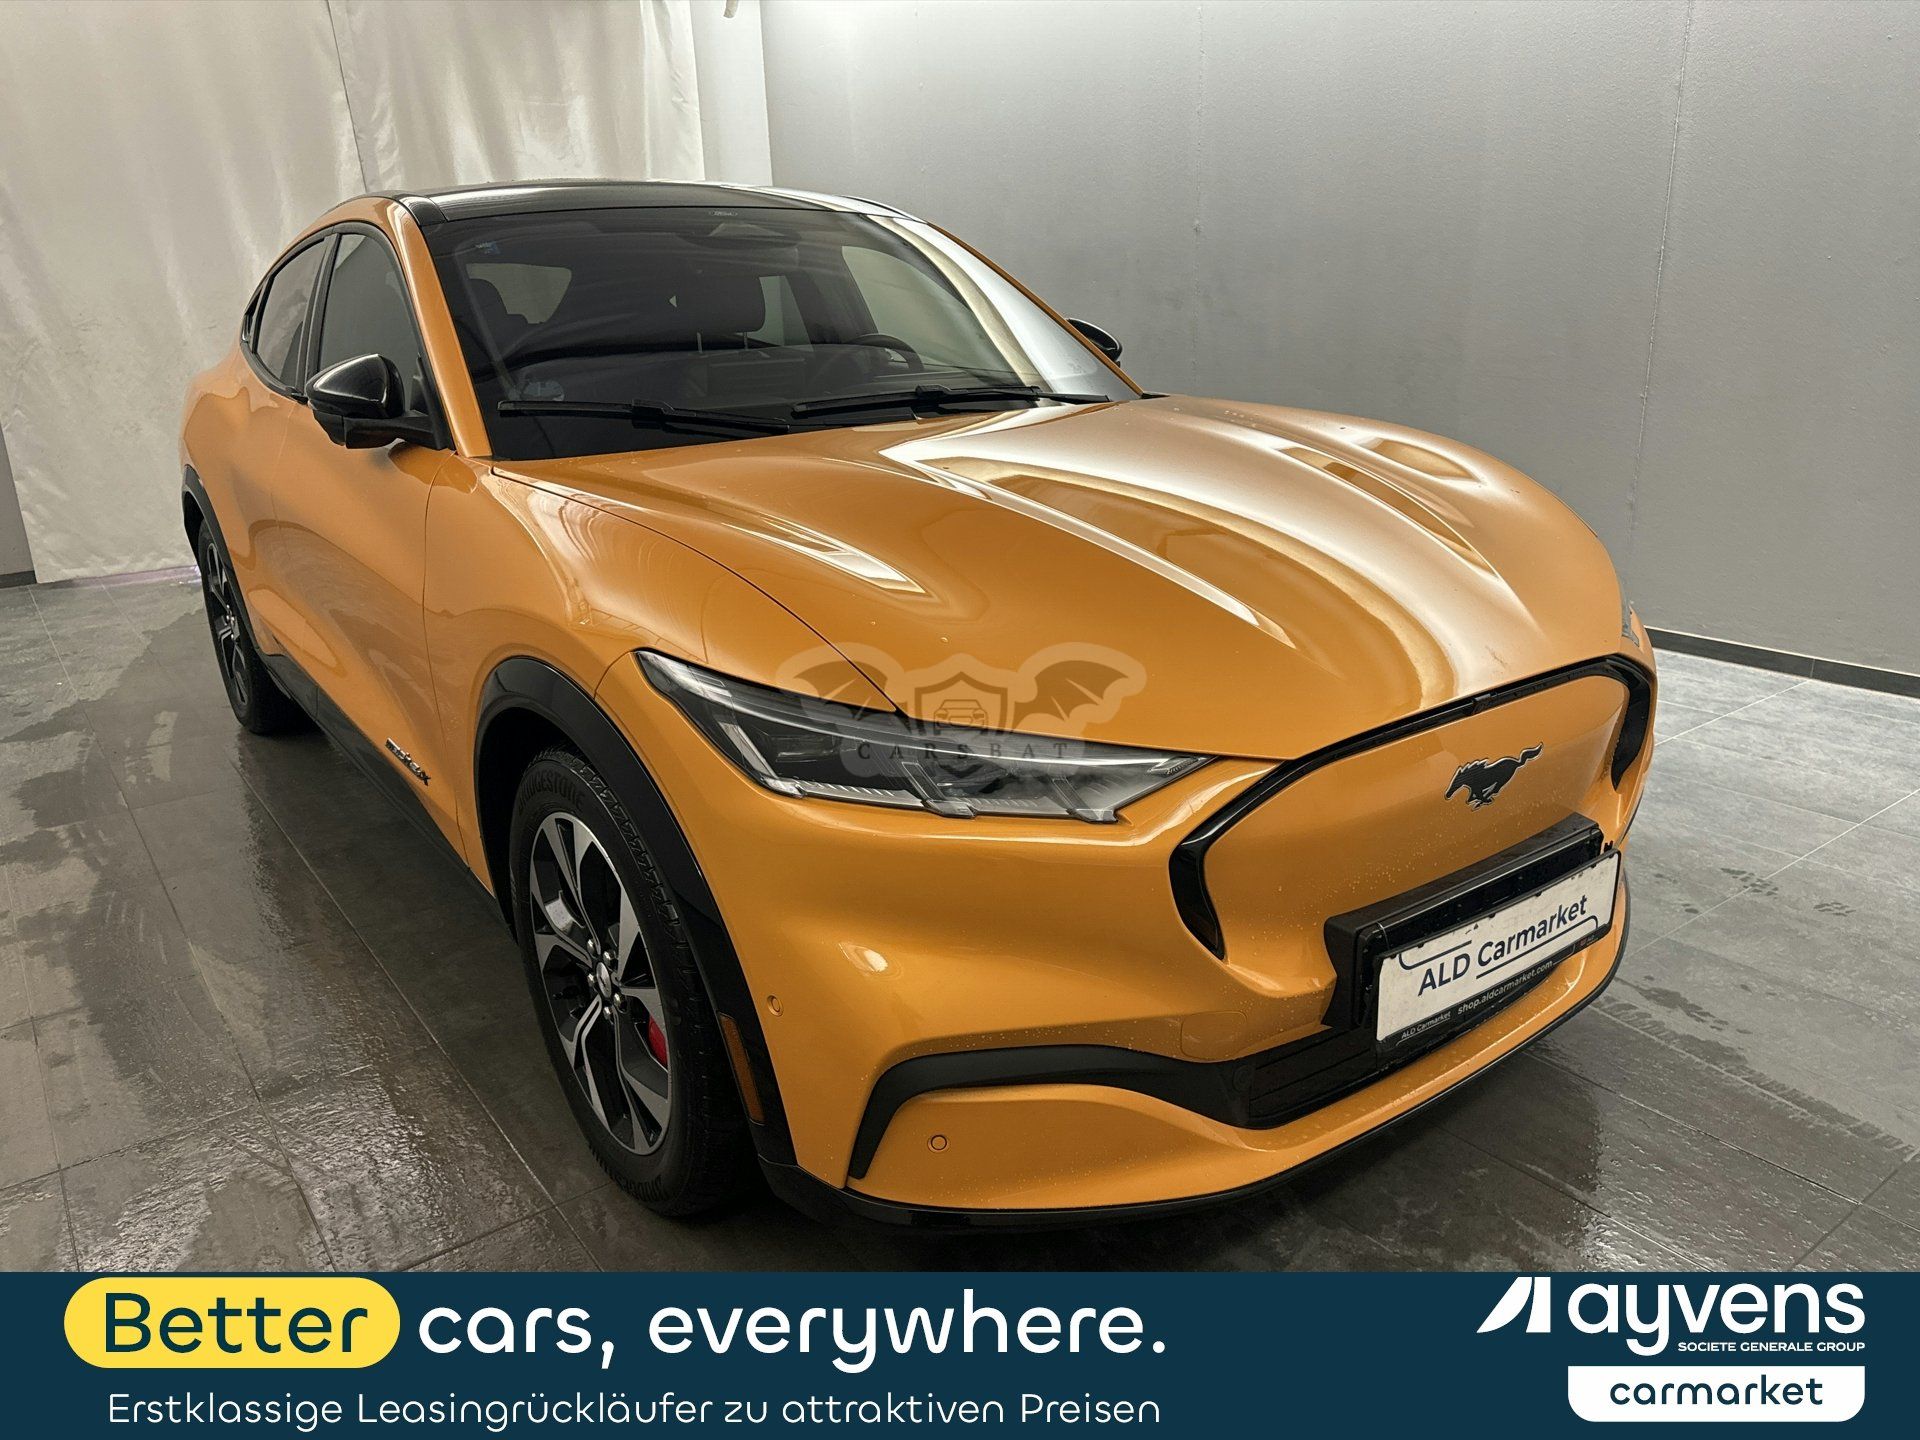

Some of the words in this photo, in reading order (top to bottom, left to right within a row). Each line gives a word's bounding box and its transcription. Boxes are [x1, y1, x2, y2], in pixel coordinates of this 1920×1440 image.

[1417, 952, 1471, 997] ALD
[1477, 894, 1588, 967] Carmarket
[1457, 960, 1554, 1015] shop.aldcarmarket.com
